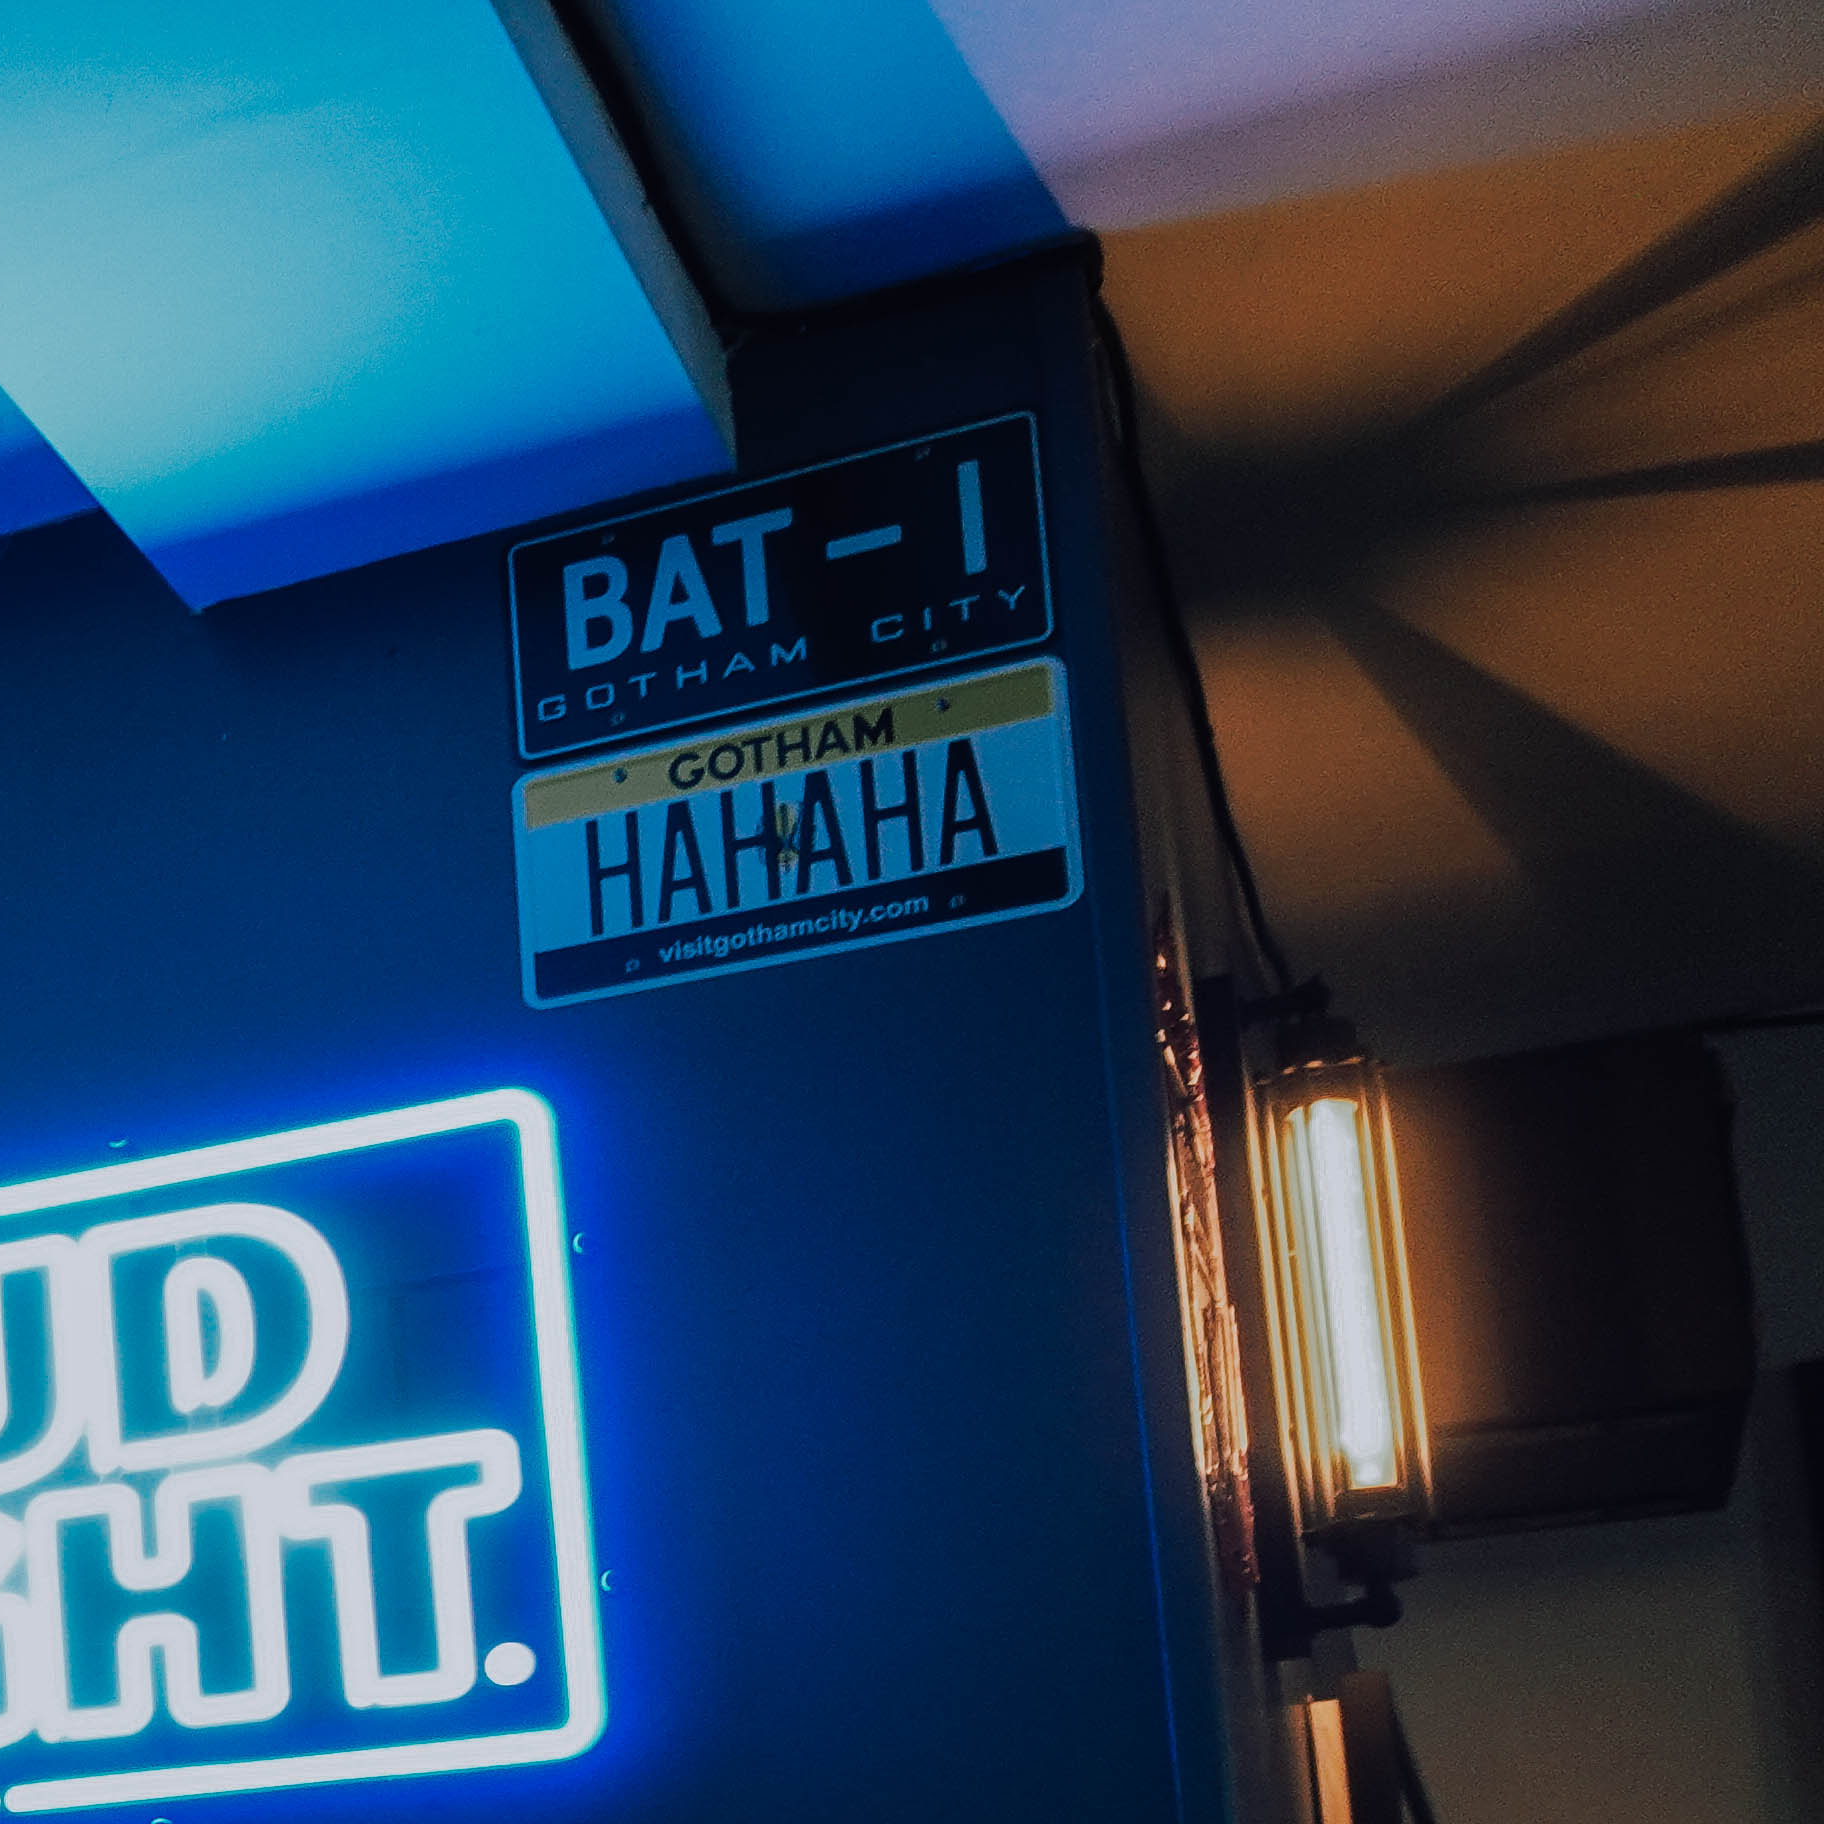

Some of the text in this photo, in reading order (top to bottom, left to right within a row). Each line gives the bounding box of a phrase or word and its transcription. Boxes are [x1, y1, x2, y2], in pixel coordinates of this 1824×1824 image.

[537, 585, 1026, 722] GOTHAM CITY
[668, 708, 897, 791] GOTHAM
[585, 739, 999, 938] HAHAHA
[659, 896, 930, 965] visitgothamcity.com
